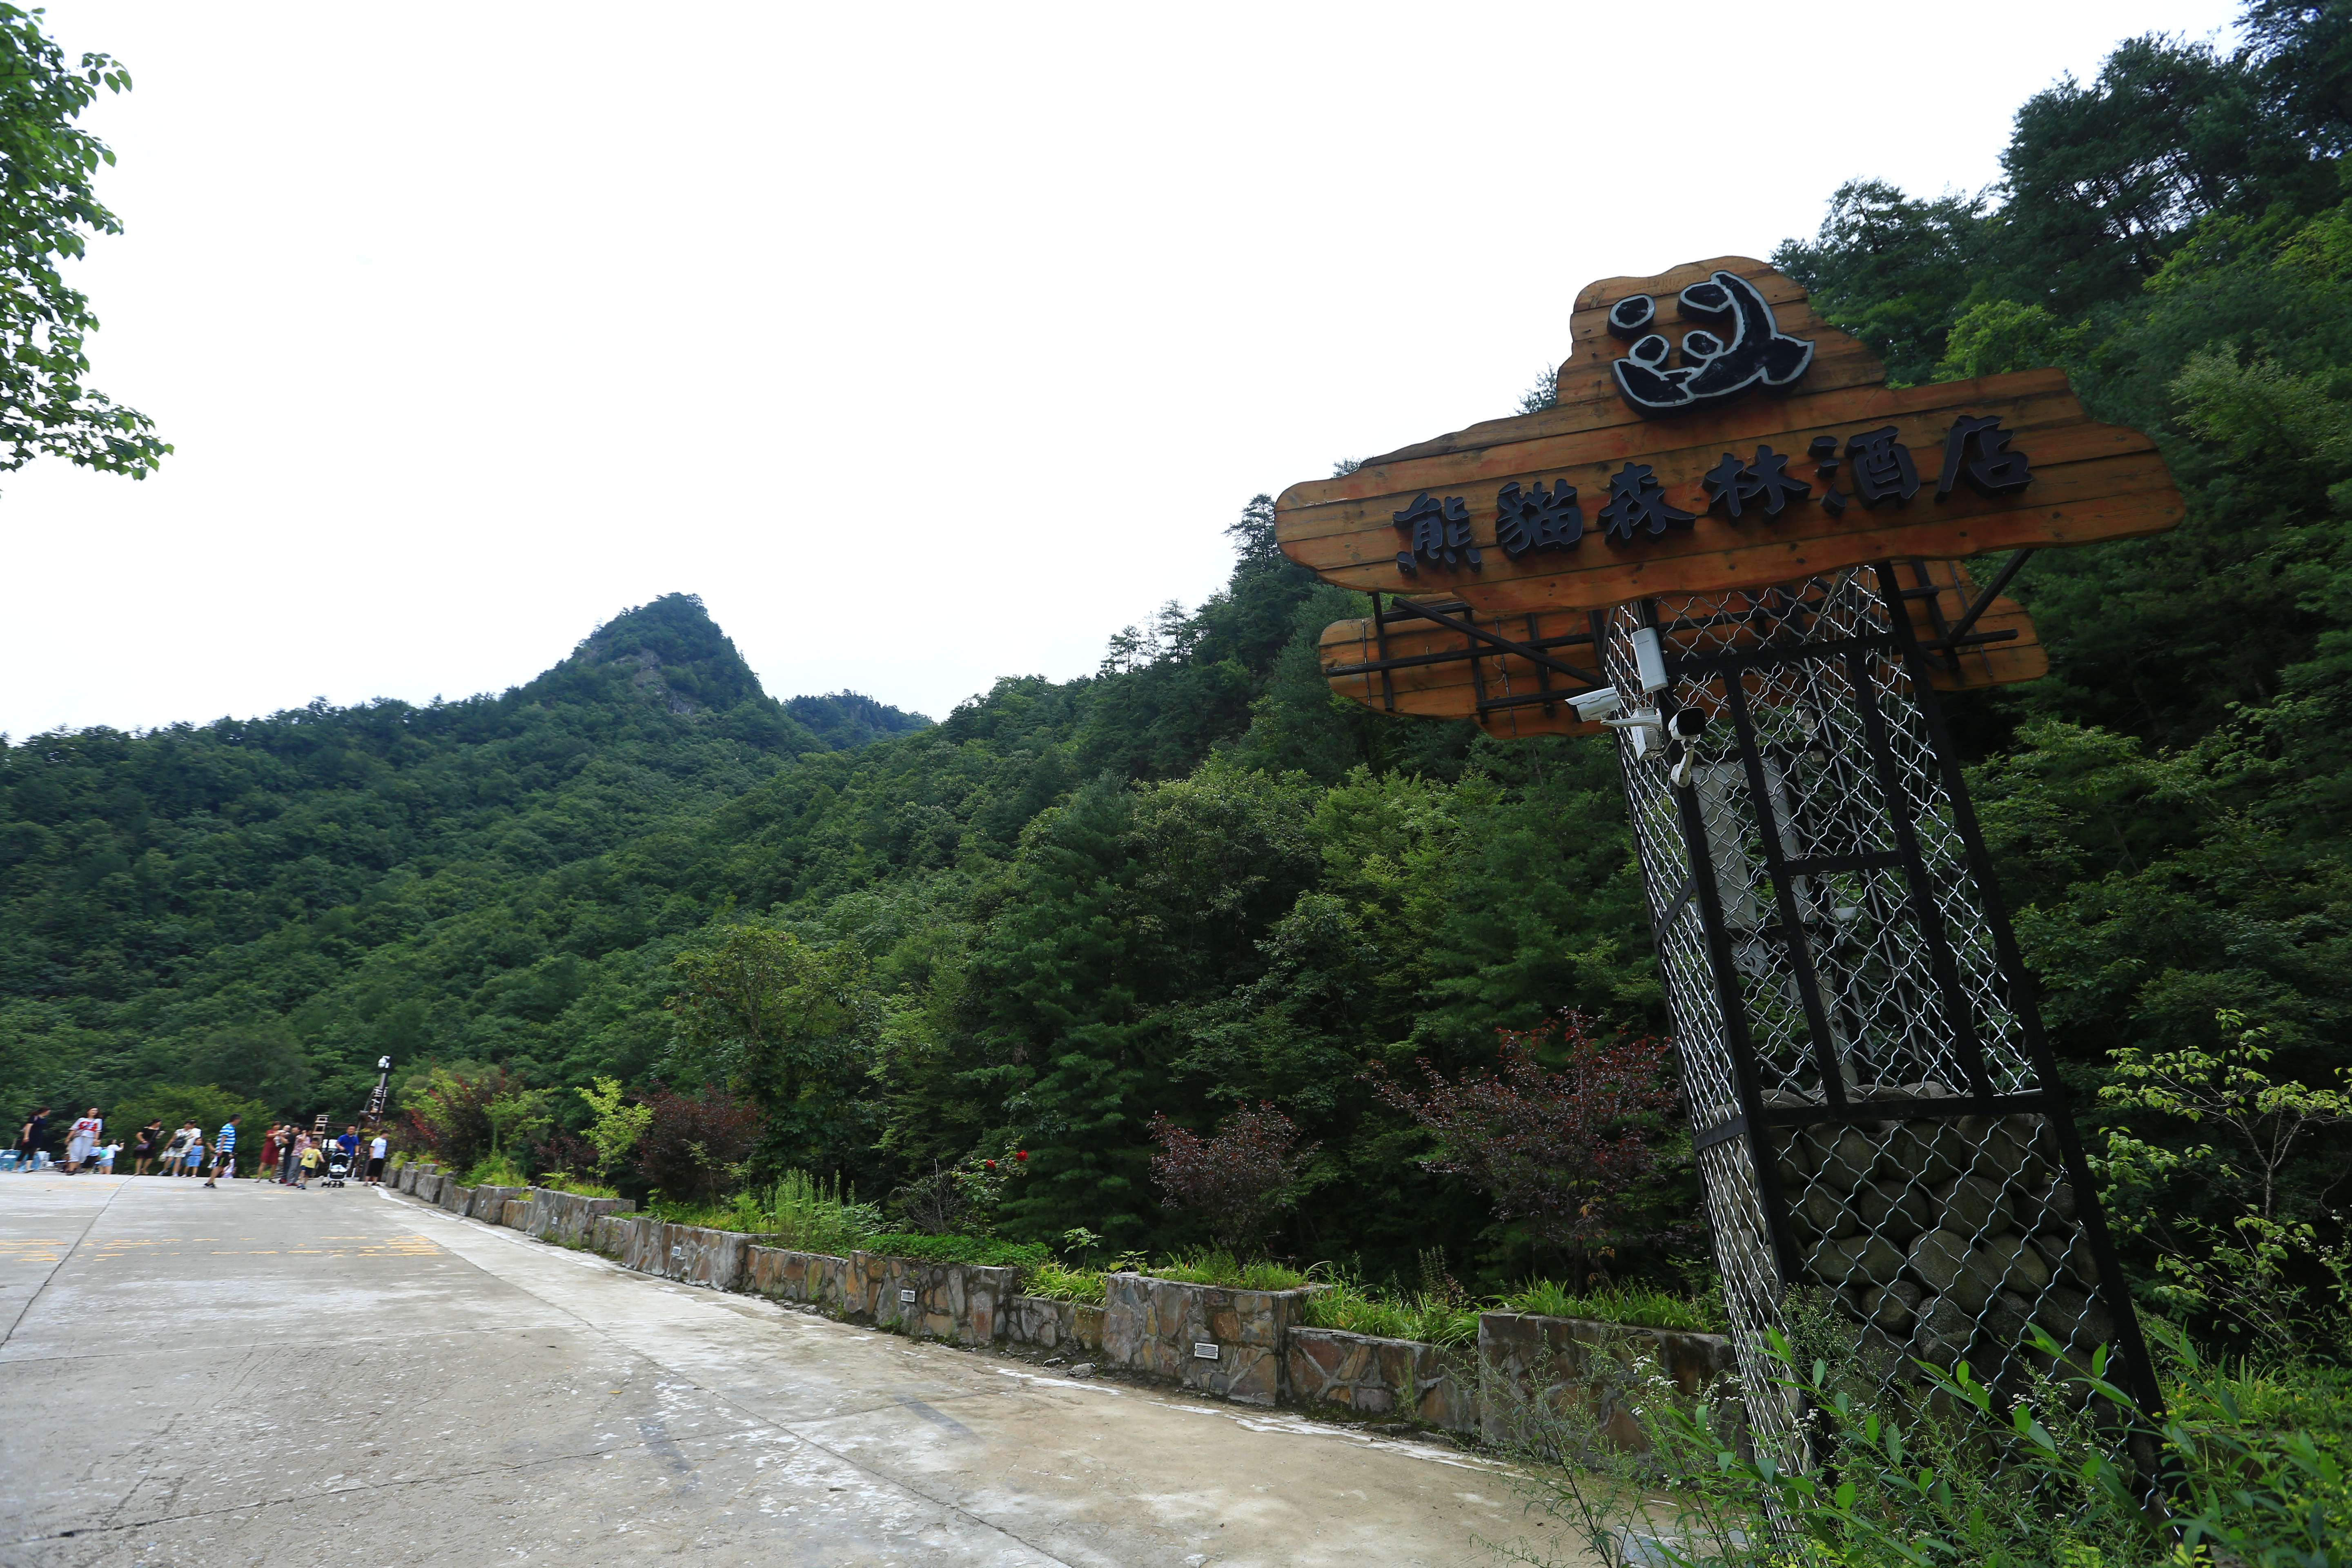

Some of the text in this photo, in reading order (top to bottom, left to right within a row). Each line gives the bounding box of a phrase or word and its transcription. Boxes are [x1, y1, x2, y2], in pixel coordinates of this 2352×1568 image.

[1392, 415, 2034, 572] 熊貓森林酒店
